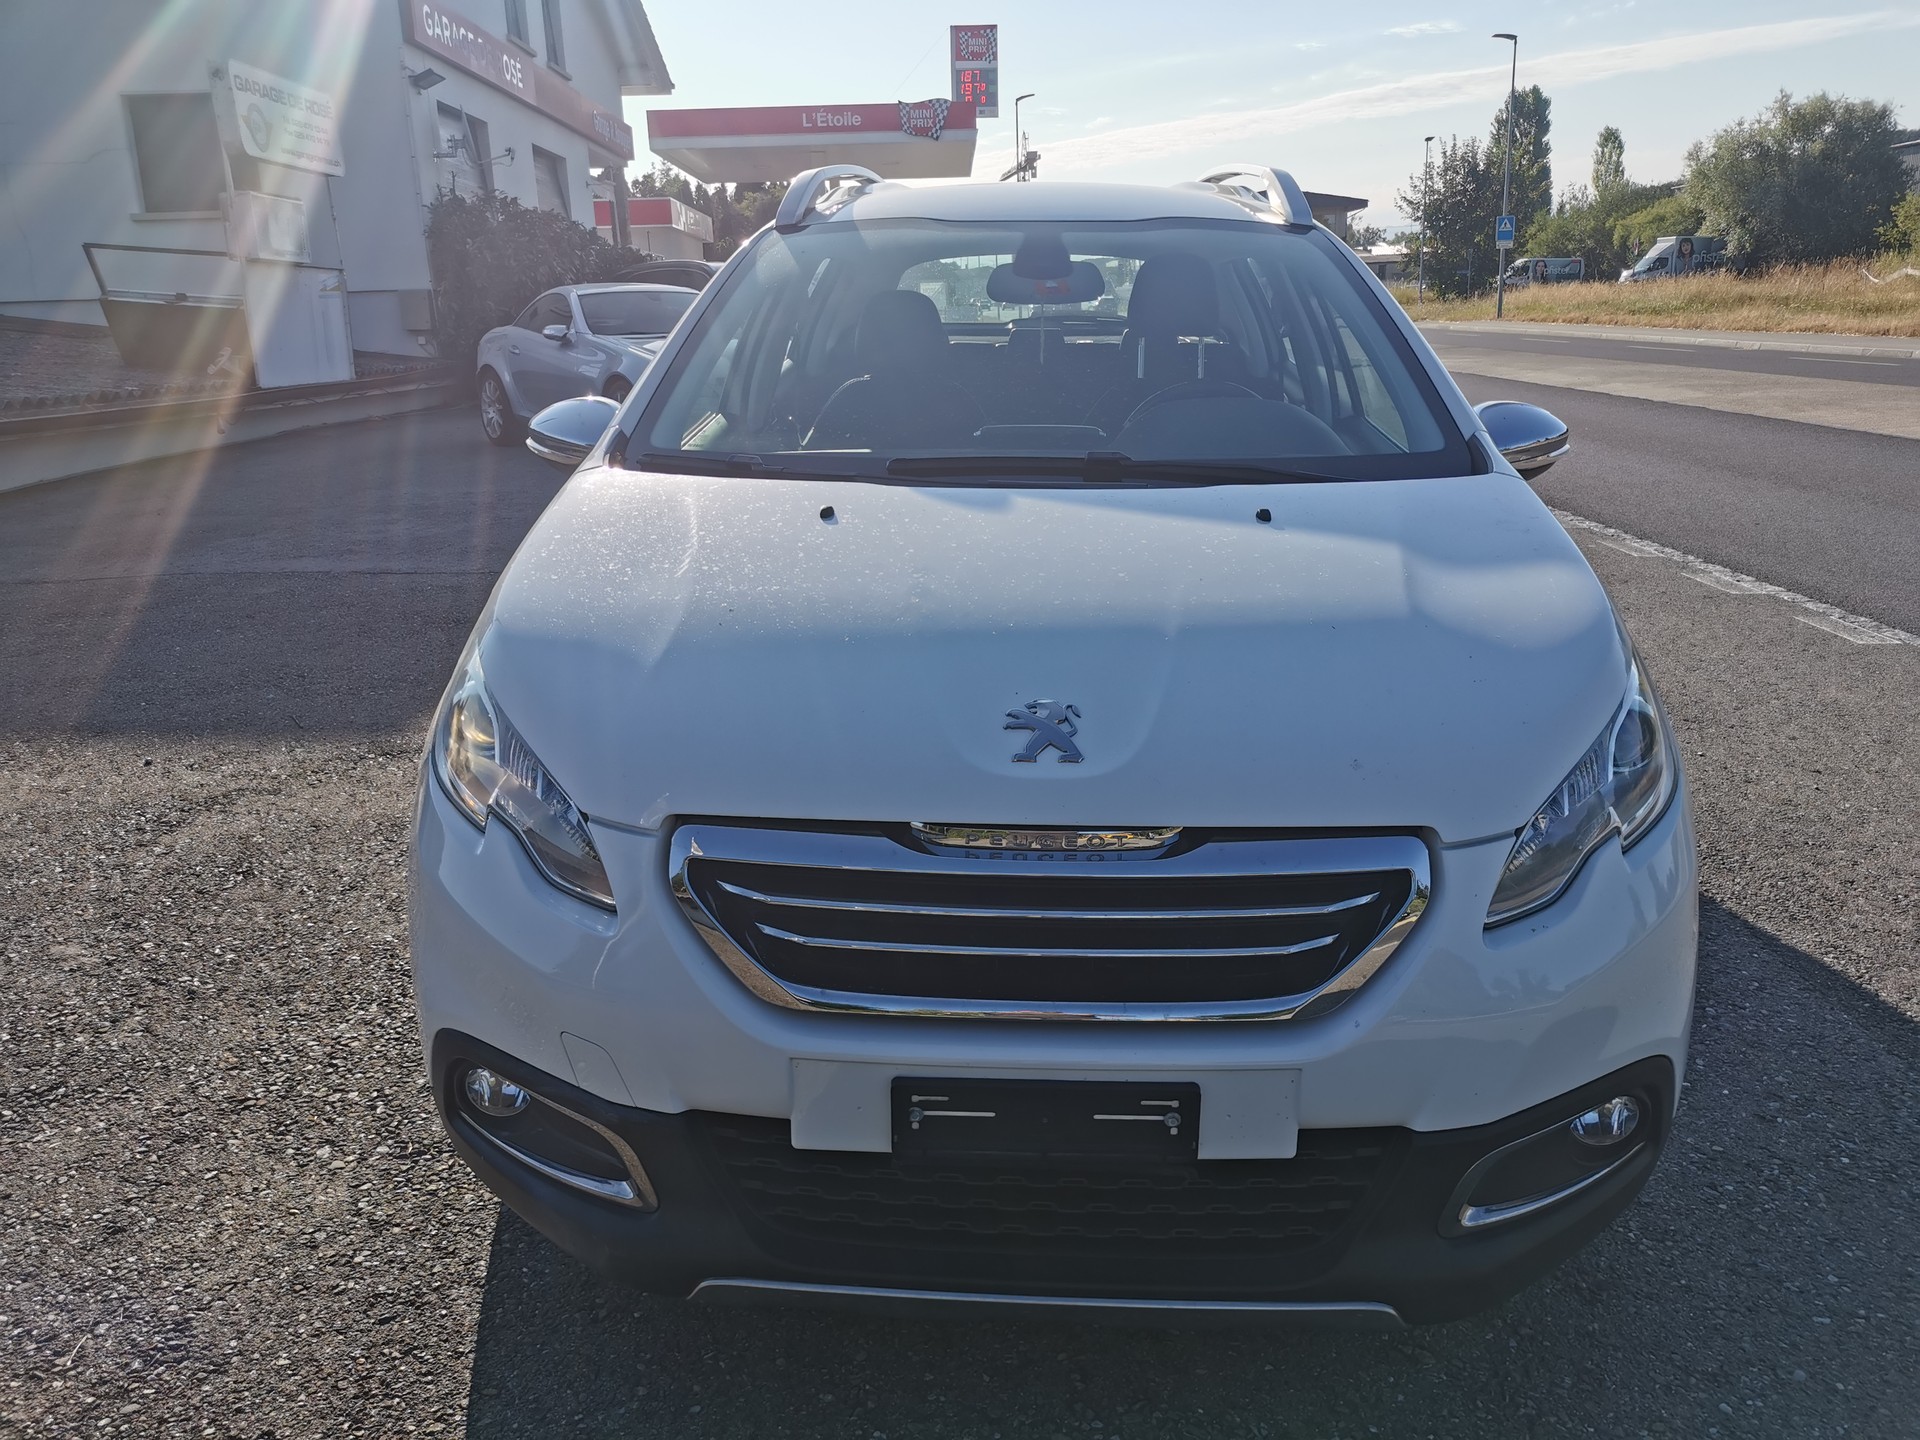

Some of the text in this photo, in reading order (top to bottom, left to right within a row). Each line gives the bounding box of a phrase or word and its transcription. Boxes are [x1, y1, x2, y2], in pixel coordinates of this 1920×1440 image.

[968, 38, 987, 46] MINI
[233, 75, 287, 106] GARAGE
[802, 108, 862, 128] L'Étoile
[910, 108, 934, 119] MINI
[910, 118, 934, 128] PRIX
[1543, 264, 1568, 278] pfister
[964, 833, 1128, 849] PEUGEOT
